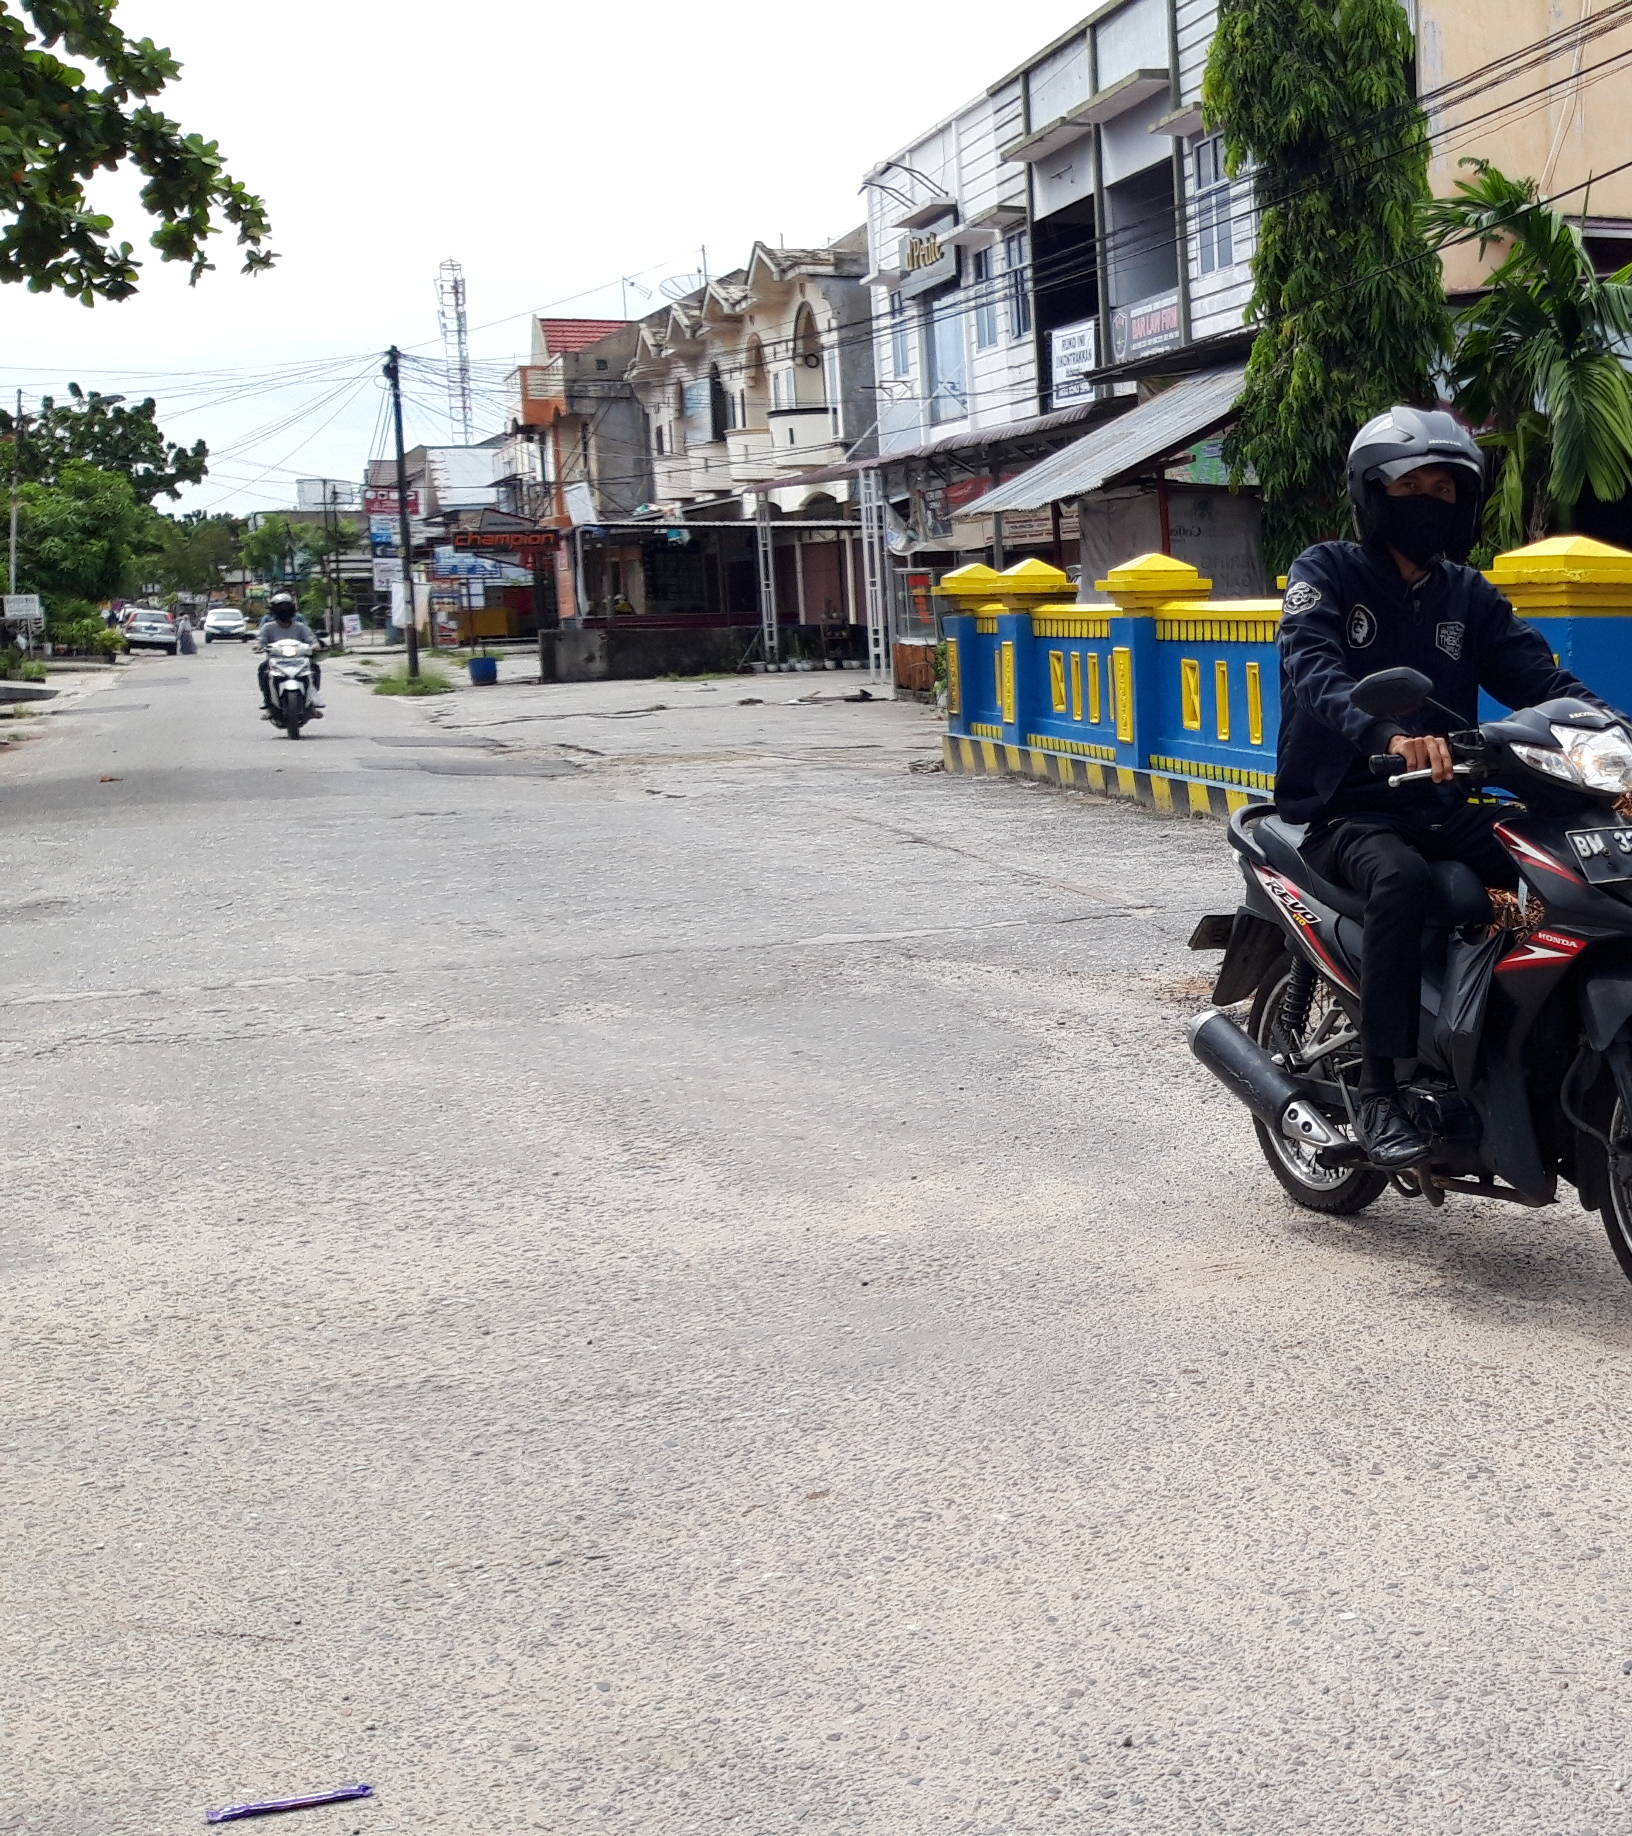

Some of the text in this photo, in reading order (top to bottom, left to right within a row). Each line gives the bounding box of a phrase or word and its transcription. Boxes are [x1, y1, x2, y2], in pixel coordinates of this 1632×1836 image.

[454, 531, 555, 547] champion
[1573, 834, 1606, 858] BM
[1265, 880, 1320, 922] REVO
[1538, 932, 1579, 948] HONDA
